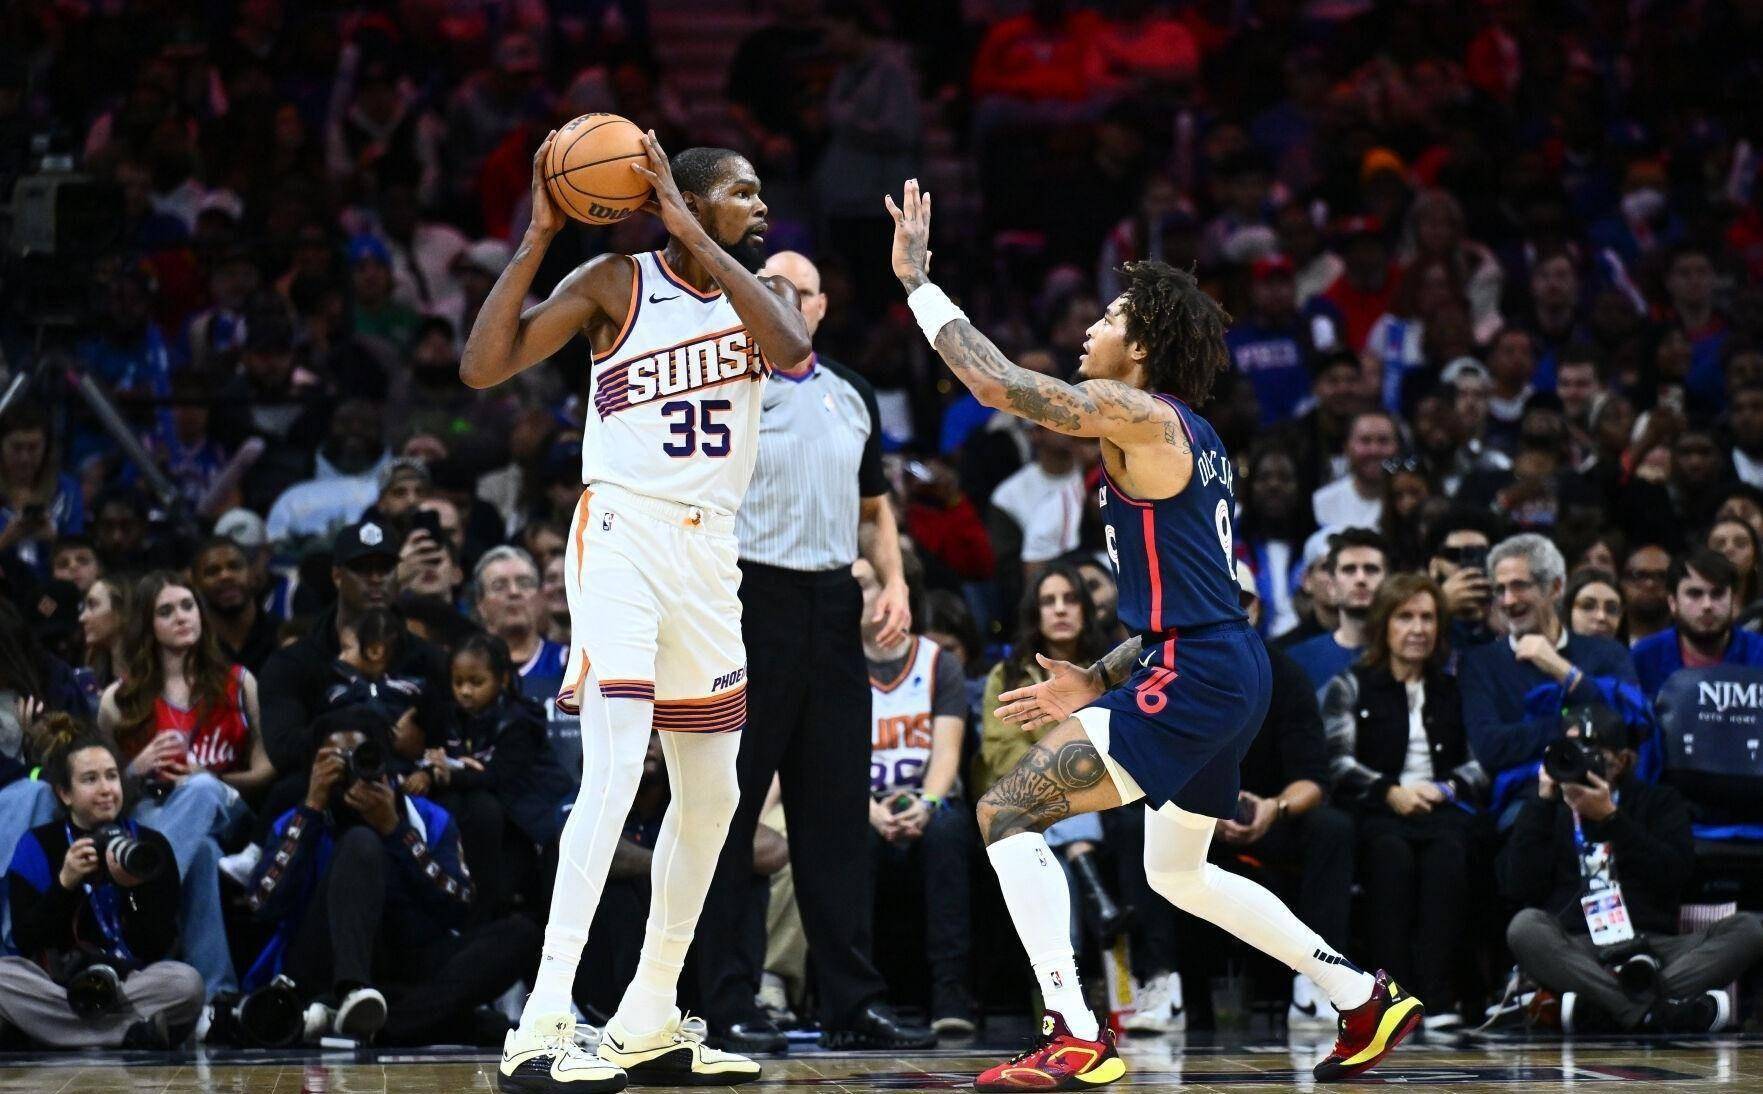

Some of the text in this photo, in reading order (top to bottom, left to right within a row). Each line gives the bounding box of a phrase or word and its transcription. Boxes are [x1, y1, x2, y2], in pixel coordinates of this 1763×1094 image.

[627, 331, 748, 405] SUNS
[661, 399, 732, 458] 35
[711, 664, 747, 693] PHOE
[1134, 666, 1179, 714] 76
[1697, 680, 1757, 712] NJM
[872, 712, 933, 751] UNS
